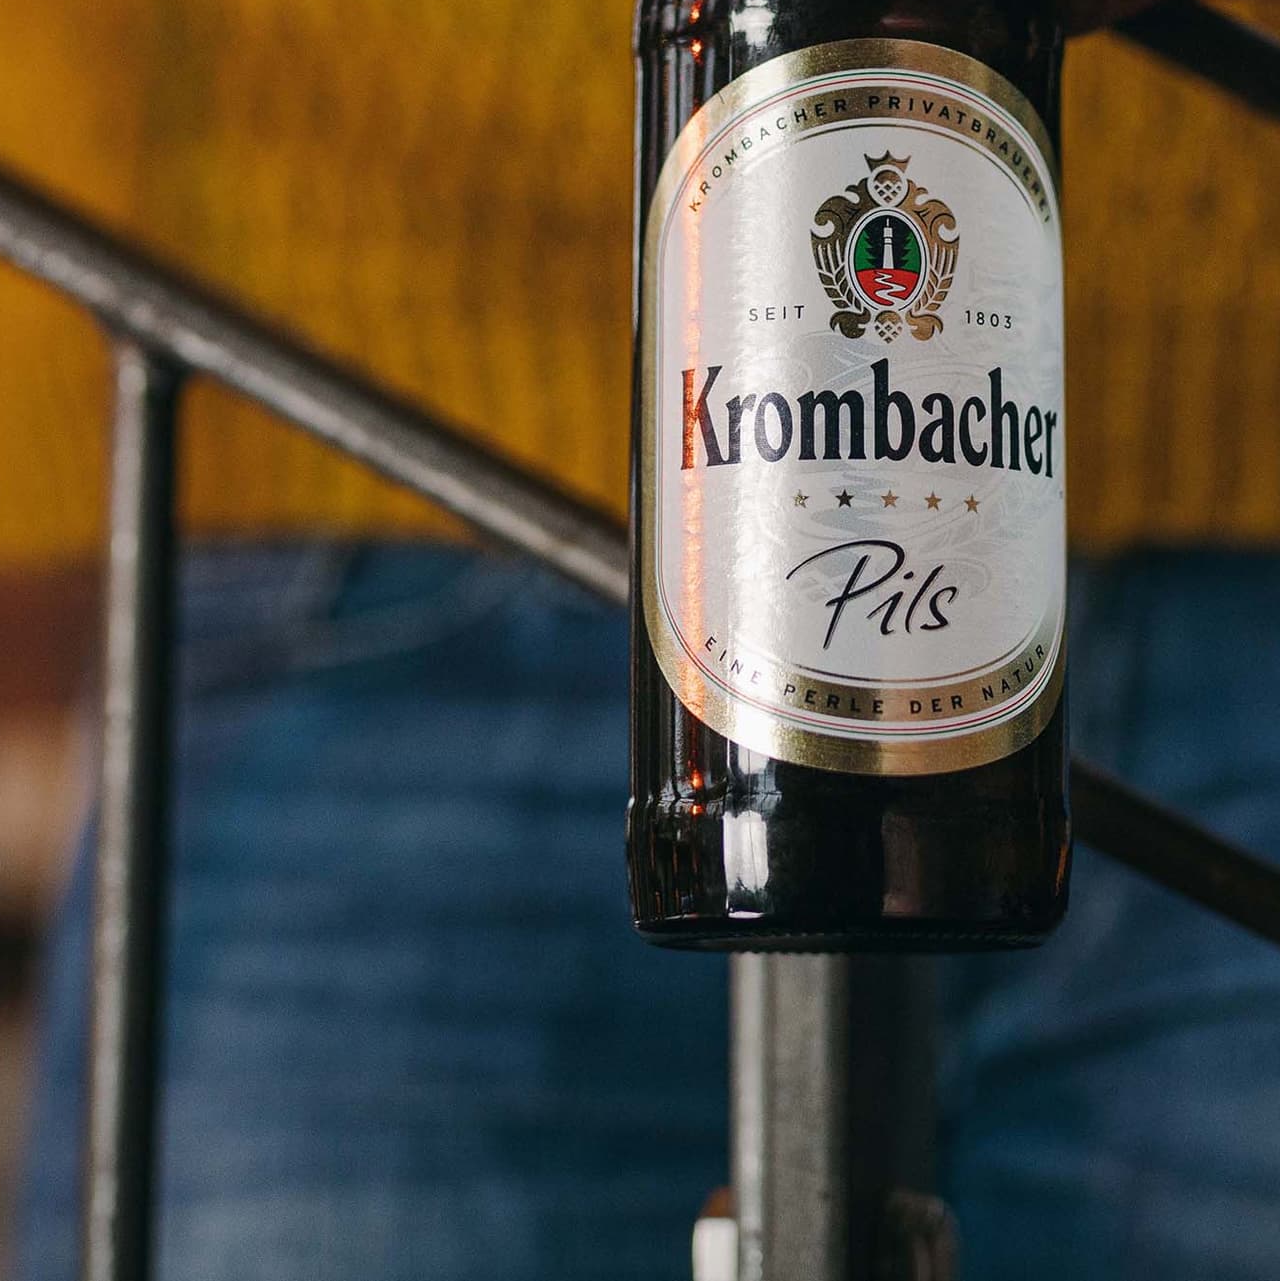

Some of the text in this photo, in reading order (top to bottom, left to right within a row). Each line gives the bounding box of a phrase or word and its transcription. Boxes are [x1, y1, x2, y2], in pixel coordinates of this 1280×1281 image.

[688, 95, 1051, 224] KROMBACHER PRIVATBRAUEREI
[748, 305, 1014, 329] SEIT 1803
[680, 357, 1058, 479] Krombacher
[786, 539, 958, 650] Pils
[704, 635, 1046, 715] EINE PERLE DER NATUR
